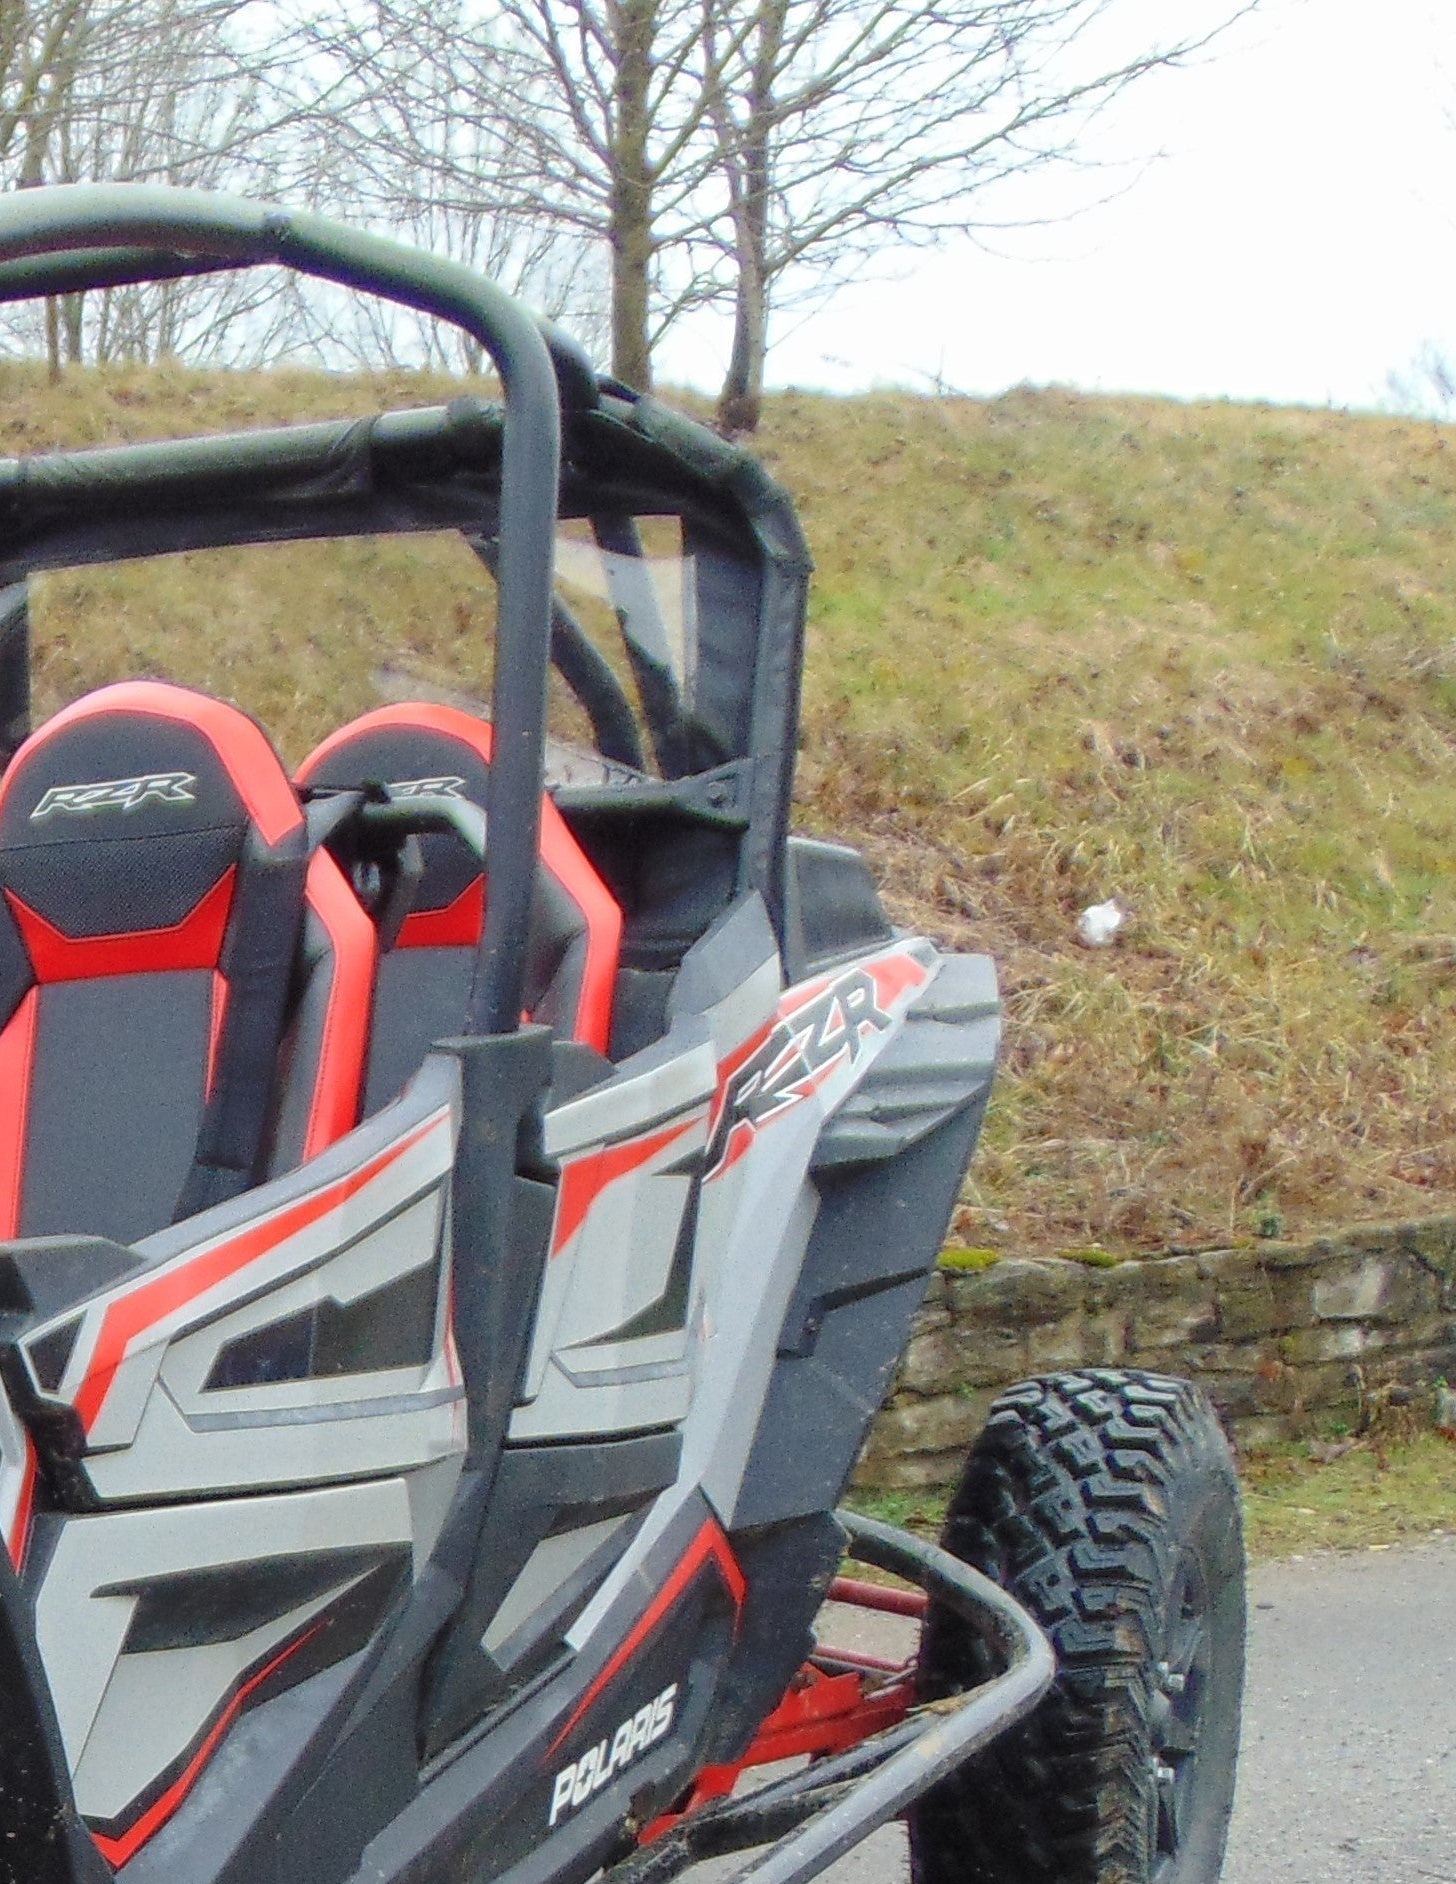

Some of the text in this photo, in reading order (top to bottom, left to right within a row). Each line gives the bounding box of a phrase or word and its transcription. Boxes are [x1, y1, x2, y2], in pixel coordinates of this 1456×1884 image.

[30, 772, 196, 819] RZR
[701, 968, 894, 1186] RZR
[548, 1682, 679, 1826] POLARIS
